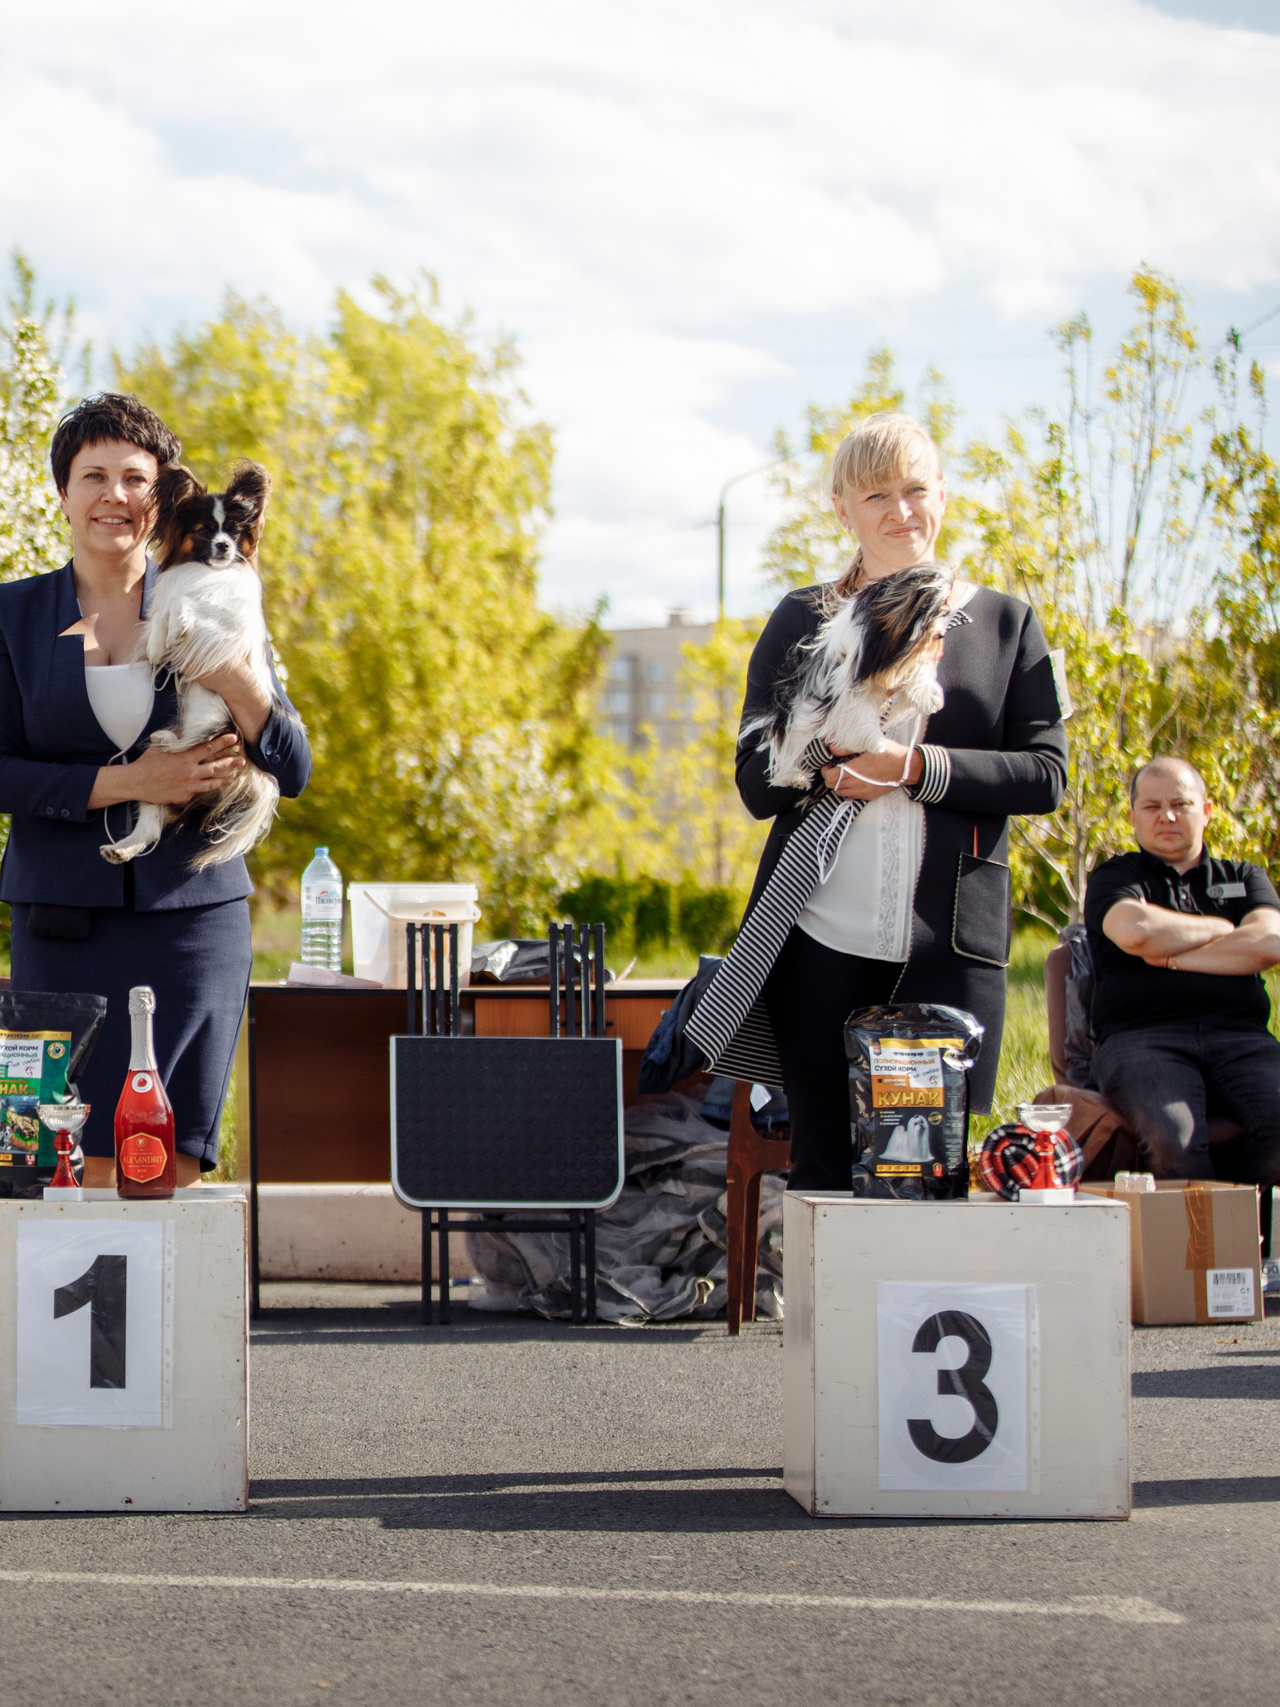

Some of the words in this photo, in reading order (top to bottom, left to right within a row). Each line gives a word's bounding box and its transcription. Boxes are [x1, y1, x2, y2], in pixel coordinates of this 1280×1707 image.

[874, 1058, 936, 1066] ПОЛНОРАЦИОННЫЙ
[878, 1091, 940, 1106] КУНАК
[53, 1254, 127, 1389] 1
[906, 1310, 999, 1464] 3
